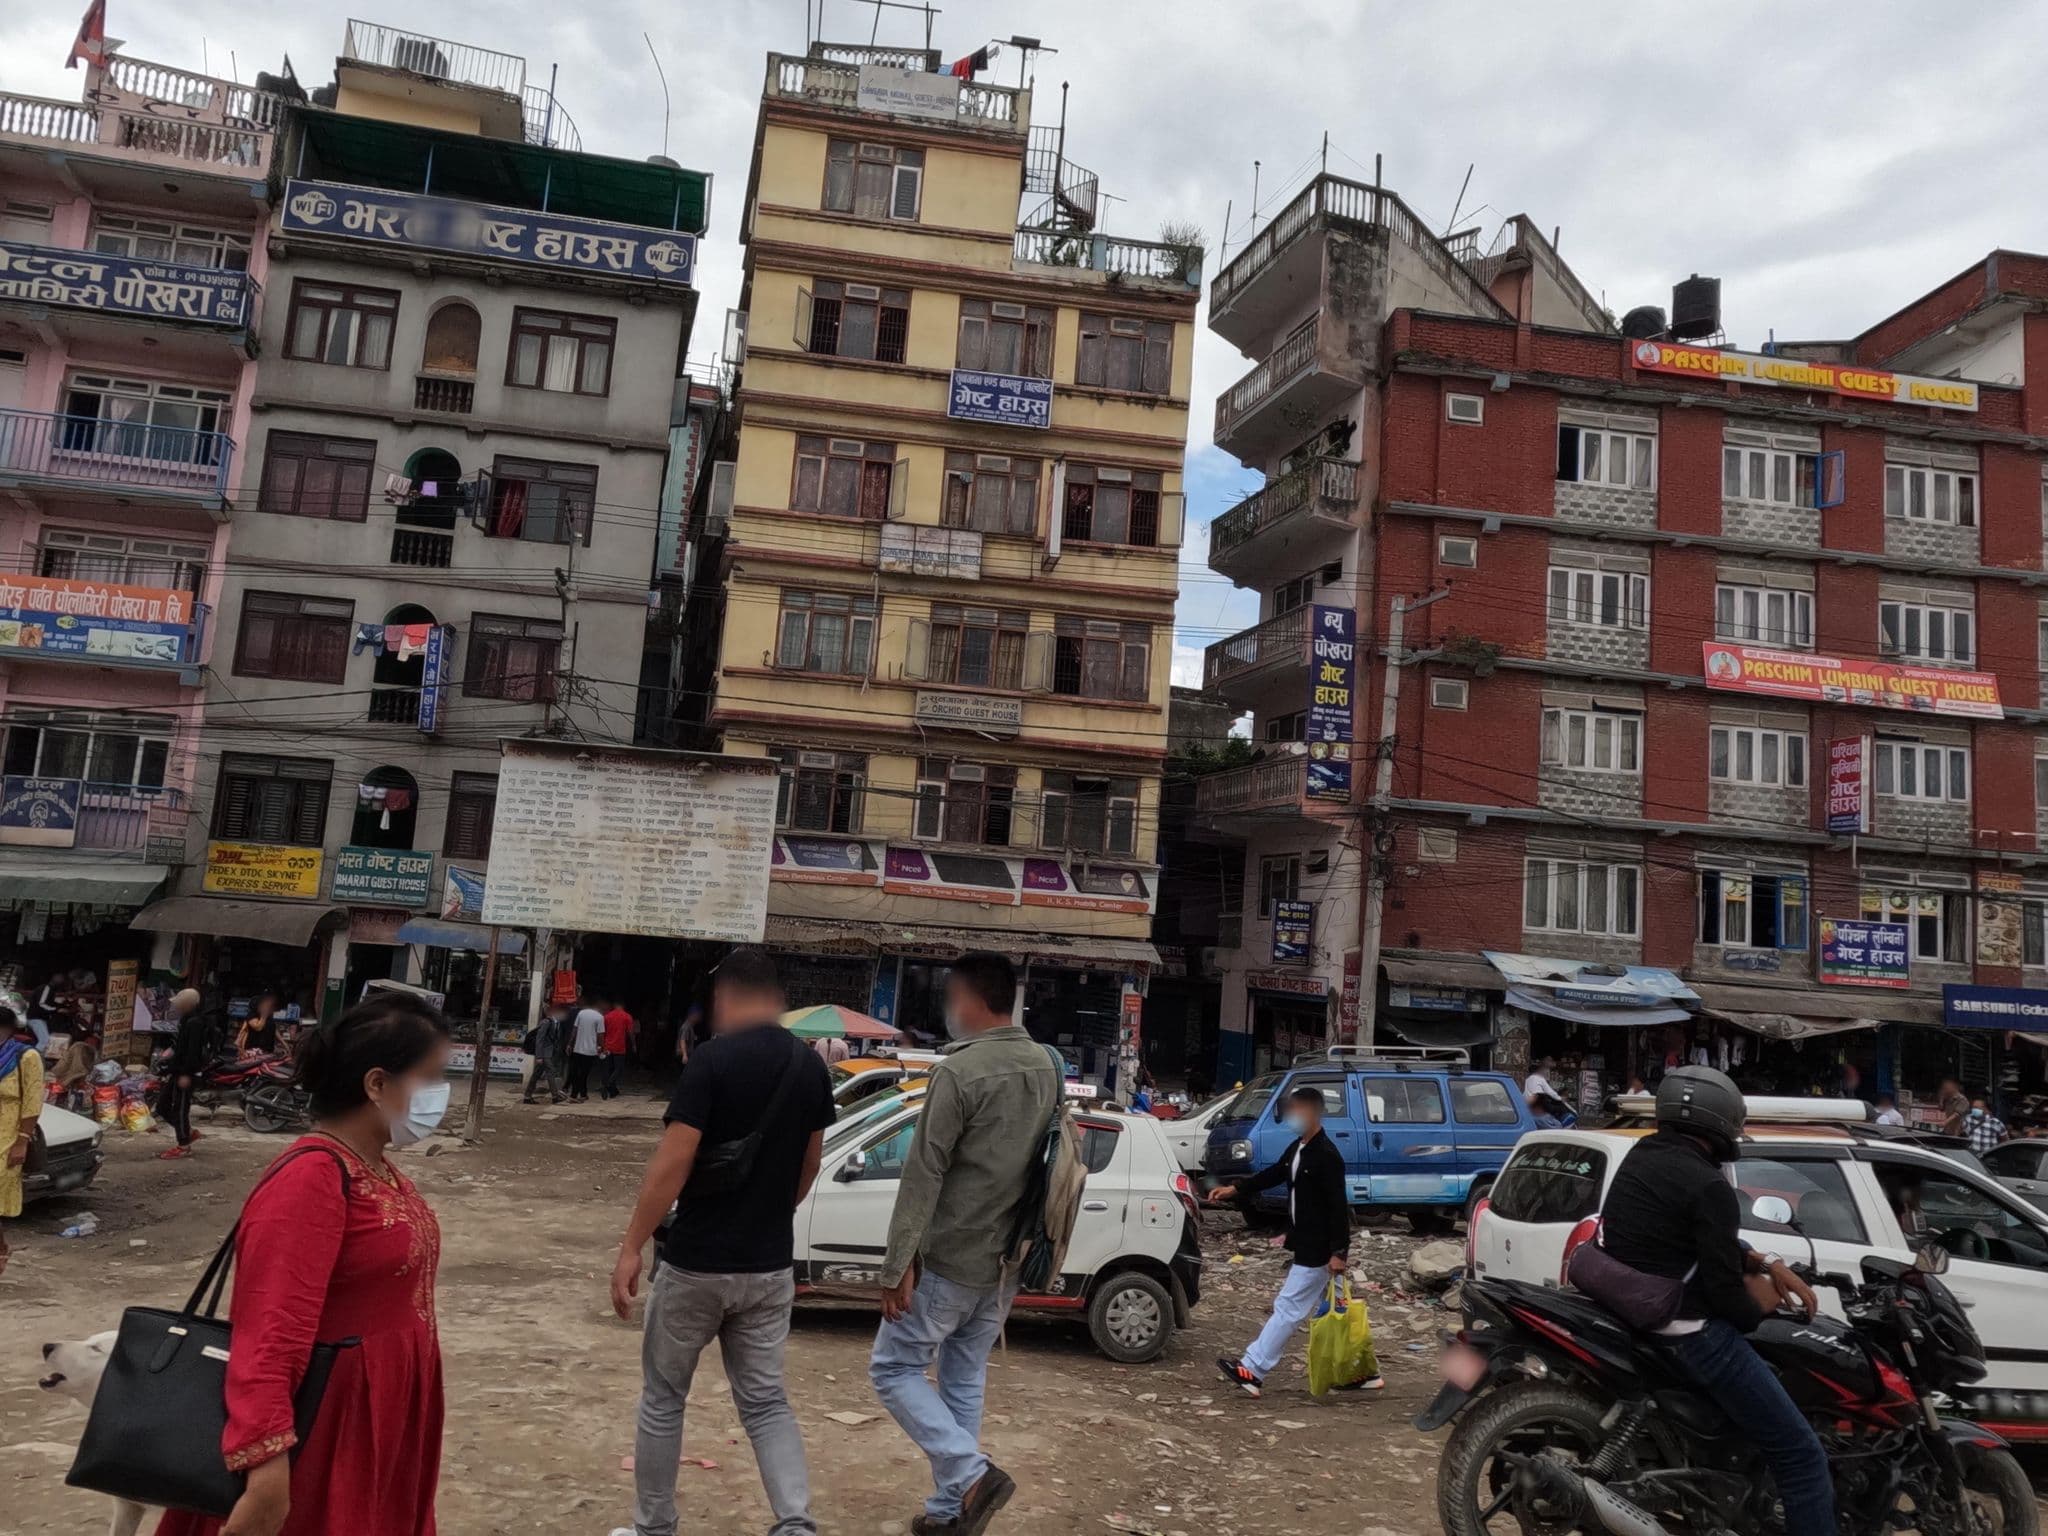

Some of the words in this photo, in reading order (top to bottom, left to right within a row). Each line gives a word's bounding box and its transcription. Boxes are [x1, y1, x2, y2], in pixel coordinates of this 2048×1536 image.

[534, 227, 639, 270] हाउस
[113, 268, 214, 317] पोखरा
[216, 303, 239, 319] लि.
[1661, 348, 1748, 377] PASCHIM
[1754, 361, 1835, 388] LUMBINI
[1839, 371, 1902, 395] GUEST
[1910, 382, 1975, 406] HOUSE
[955, 385, 994, 408] गेष्ट
[998, 395, 1049, 416] हाउस
[110, 590, 146, 621] पोखरा
[165, 594, 183, 625] लि.
[1324, 611, 1345, 636] न्यू
[1314, 635, 1354, 661] पोखरा
[1320, 660, 1346, 684] गेष्ट
[1743, 660, 1813, 683] PASCHIM
[1818, 668, 1884, 691] LUMBINI
[1889, 678, 1939, 698] GUEST
[1944, 684, 1997, 704] HOUSE
[1314, 686, 1350, 706] हाउस
[931, 705, 962, 715] ORCHID
[963, 708, 990, 718] GUEST
[992, 710, 1019, 721] HOUSE
[23, 779, 66, 790] होटल
[1830, 779, 1860, 798] गेष्ट
[1829, 796, 1860, 815] हाउस
[338, 852, 365, 870] भरत
[367, 850, 397, 872] गेष्ट
[397, 857, 431, 875] हाउस
[901, 864, 922, 873] Ncell
[208, 866, 238, 877] FEDEX
[240, 868, 263, 880] DTDC
[267, 870, 303, 881] SKYNET
[336, 873, 371, 888] BHARAT
[371, 876, 399, 890] GUEST
[399, 879, 427, 892] HOUSE
[1038, 875, 1058, 884] Ncell
[216, 877, 260, 889] EXPRESS
[262, 880, 299, 892] SERVICE
[1837, 944, 1865, 962] गेष्ट
[1870, 949, 1905, 966] हाउस
[1953, 1000, 2016, 1014] SAMSUNG
